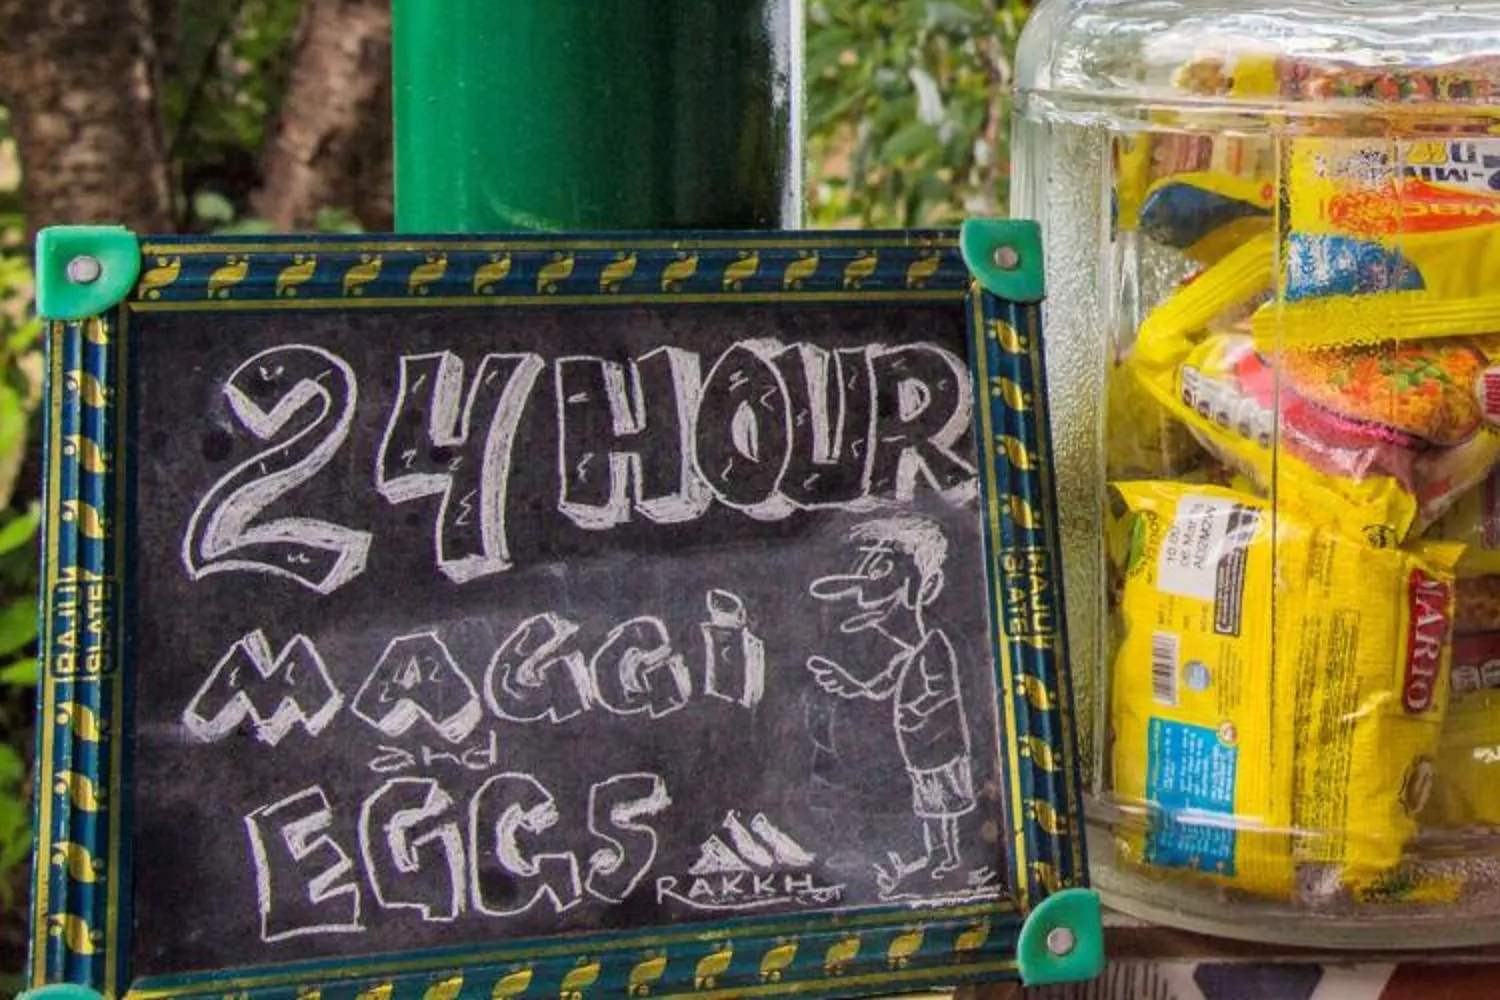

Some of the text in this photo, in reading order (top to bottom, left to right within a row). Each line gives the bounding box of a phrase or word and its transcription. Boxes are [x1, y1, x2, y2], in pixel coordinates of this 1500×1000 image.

[182, 337, 979, 594] 24 HOUR
[368, 729, 497, 772] and
[245, 773, 672, 942] EGGS
[656, 873, 814, 906] RAKKH
